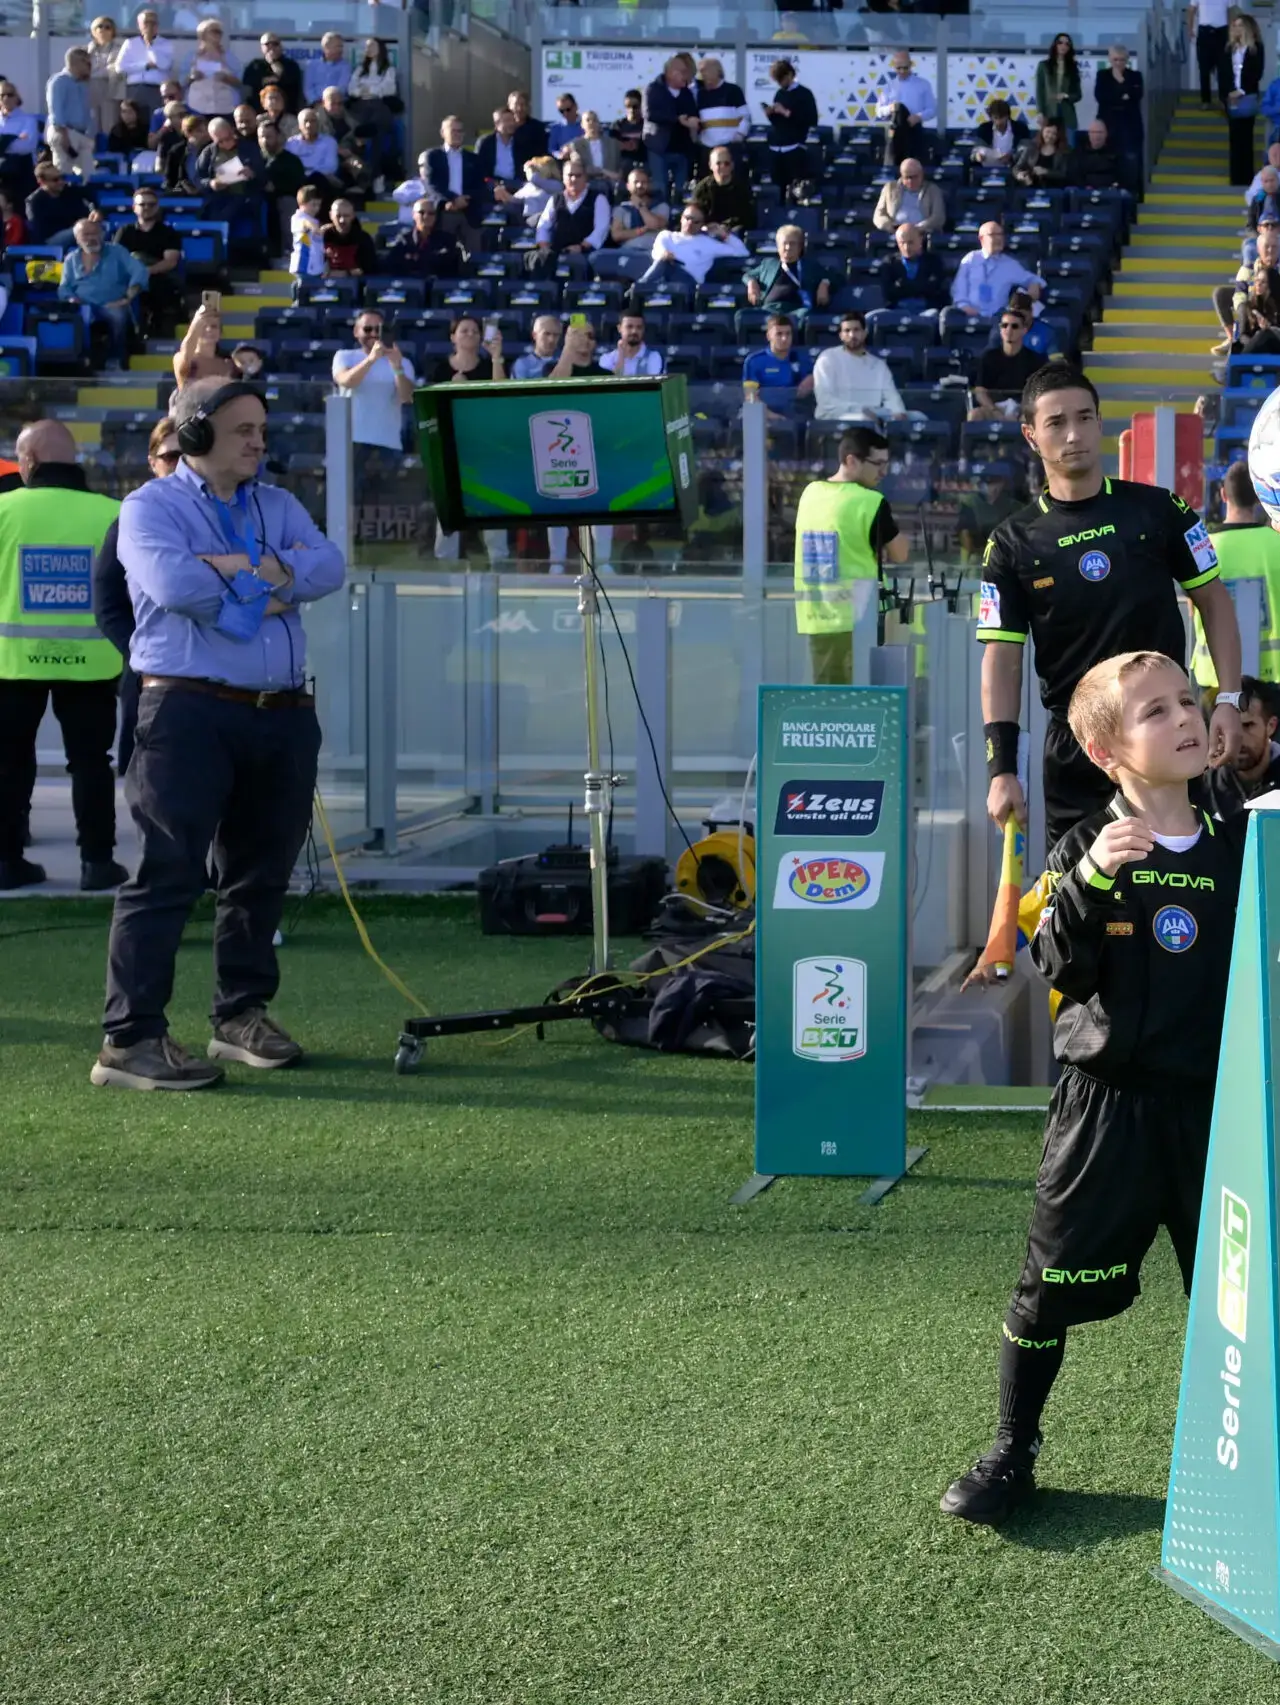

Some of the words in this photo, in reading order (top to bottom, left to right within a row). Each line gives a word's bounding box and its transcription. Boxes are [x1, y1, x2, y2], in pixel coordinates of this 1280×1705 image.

[551, 459, 577, 468] Serie
[543, 470, 589, 487] BKT
[1058, 524, 1115, 547] GIVOVA
[24, 553, 88, 572] STEWARD
[1086, 558, 1105, 571] AIA
[28, 583, 88, 603] W2666
[27, 655, 86, 665] WINCH
[782, 722, 819, 731] BANCA
[820, 722, 876, 732] POPOLARE
[782, 733, 876, 748] FRUSINATE
[805, 794, 876, 812] Zeus
[829, 813, 849, 821] gli
[851, 812, 873, 820] dei
[1132, 870, 1214, 891] GIVOVA
[806, 883, 855, 898] Dem
[1162, 918, 1189, 934] AIA
[814, 1013, 846, 1024] Serie
[802, 1028, 857, 1047] BKT
[1220, 1193, 1247, 1336] BKT
[1042, 1263, 1128, 1284] GIVOVA
[1217, 1345, 1243, 1471] Serie
